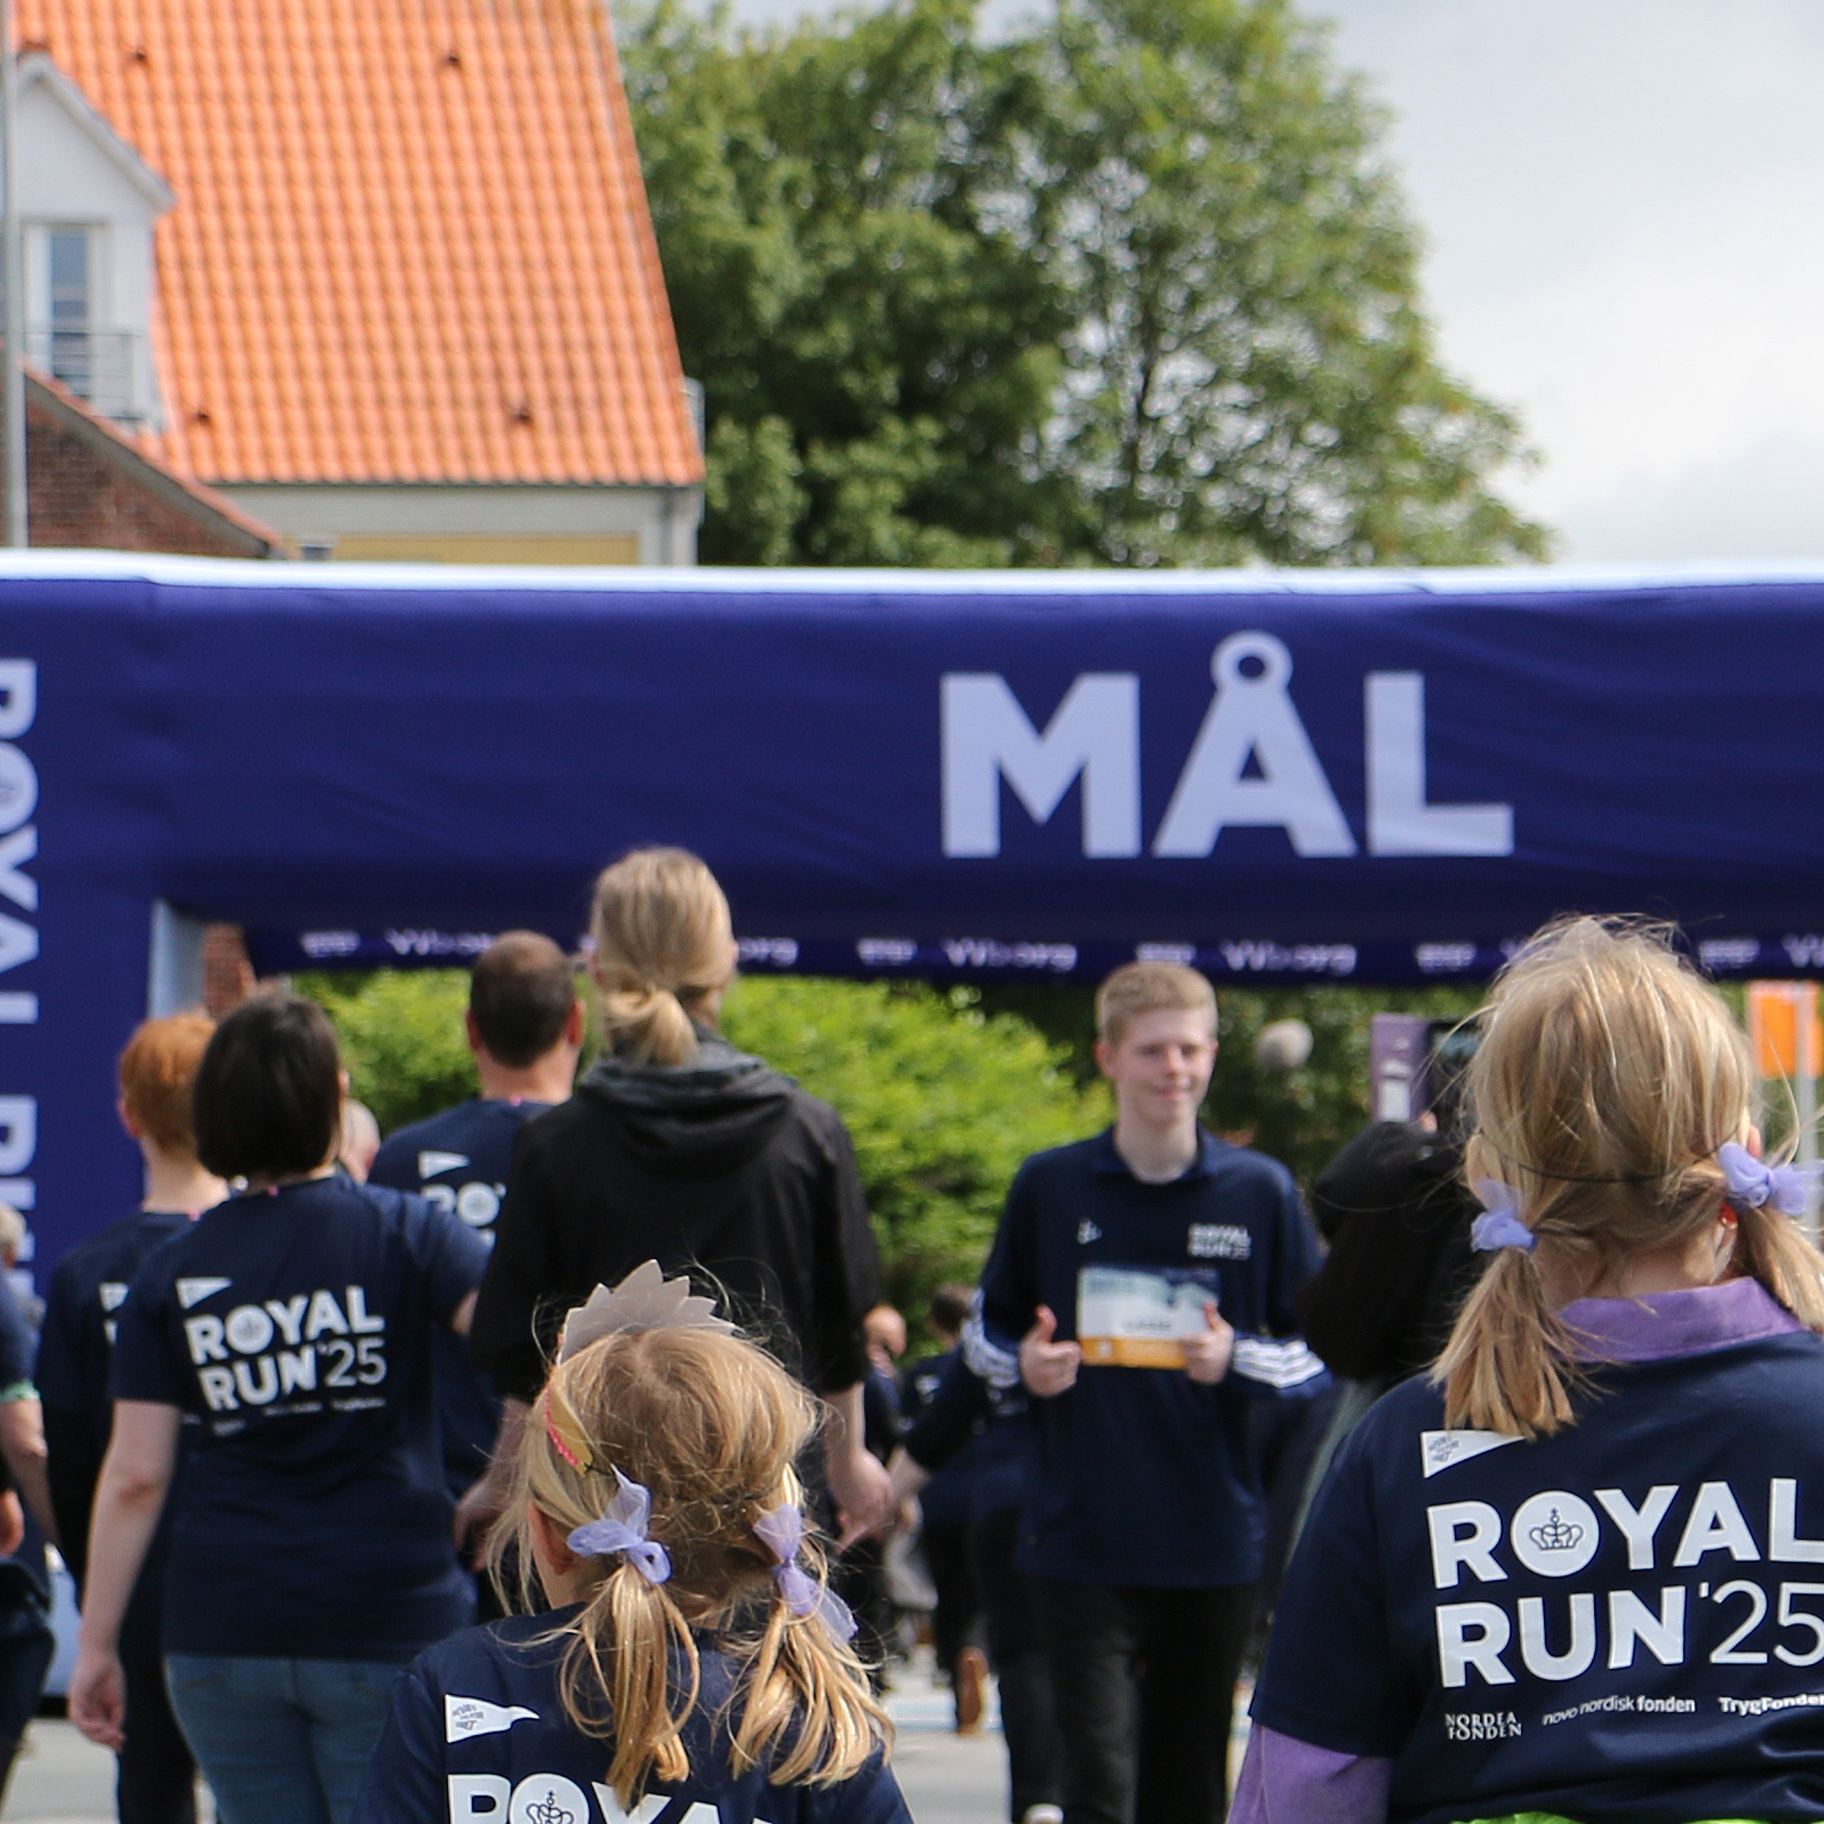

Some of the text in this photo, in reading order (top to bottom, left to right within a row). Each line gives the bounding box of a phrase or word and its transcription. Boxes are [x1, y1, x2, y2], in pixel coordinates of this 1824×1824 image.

[939, 629, 1515, 858] MÅL
[183, 1285, 386, 1365] ROYAL
[1445, 1711, 1517, 1729] NORDEA
[1542, 1706, 1578, 1726] novo
[1578, 1695, 1636, 1714] nordisk
[1637, 1694, 1696, 1713] fonden
[1448, 1722, 1522, 1741] FONDEN
